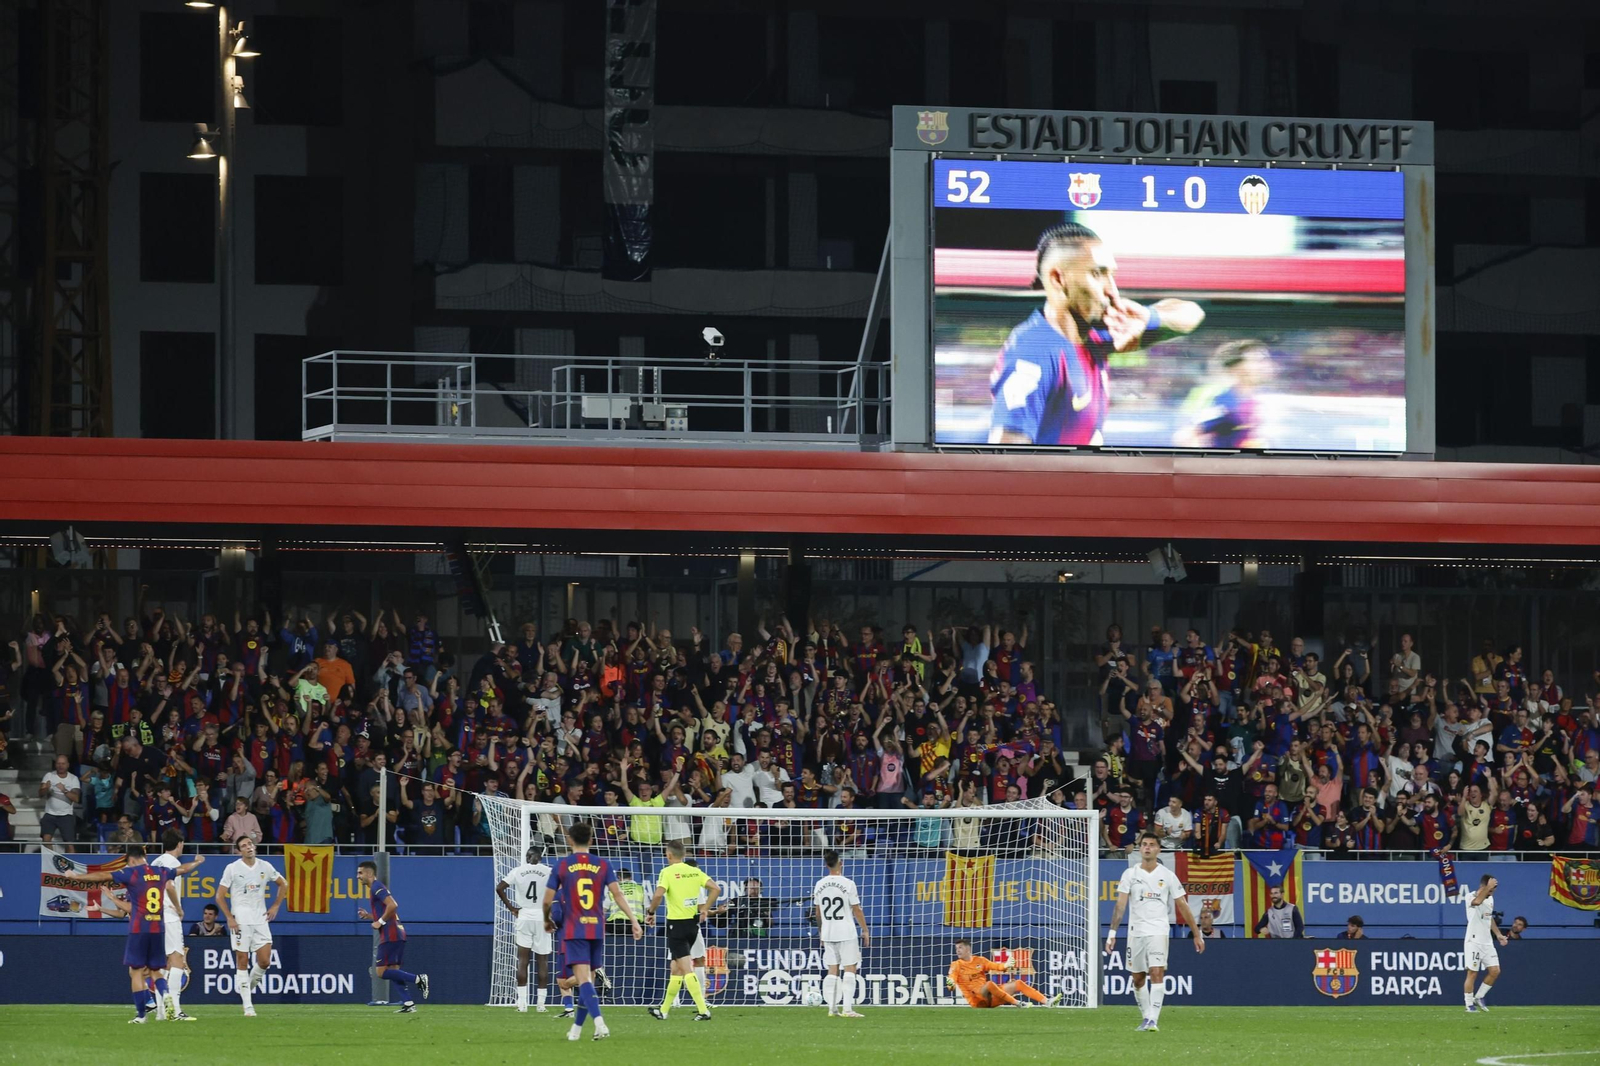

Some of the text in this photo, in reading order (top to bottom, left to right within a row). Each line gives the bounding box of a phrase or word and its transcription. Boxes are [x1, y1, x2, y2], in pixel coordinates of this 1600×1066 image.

[968, 112, 1414, 161] ESTADI JOHAN CRUYFF
[946, 170, 991, 204] 52
[567, 862, 602, 875] CUBARSÍ
[331, 877, 371, 899] LU
[525, 880, 538, 904] 4
[576, 877, 595, 911] 5
[1025, 880, 1059, 902] UN
[1210, 882, 1232, 894] FCB
[1307, 882, 1334, 904] FC
[146, 886, 161, 914] 8
[821, 896, 845, 921] 22
[204, 949, 282, 970] BAA
[1370, 951, 1482, 971] FUNDACI
[1471, 951, 1480, 961] 14
[1370, 976, 1443, 999] BARÇA
